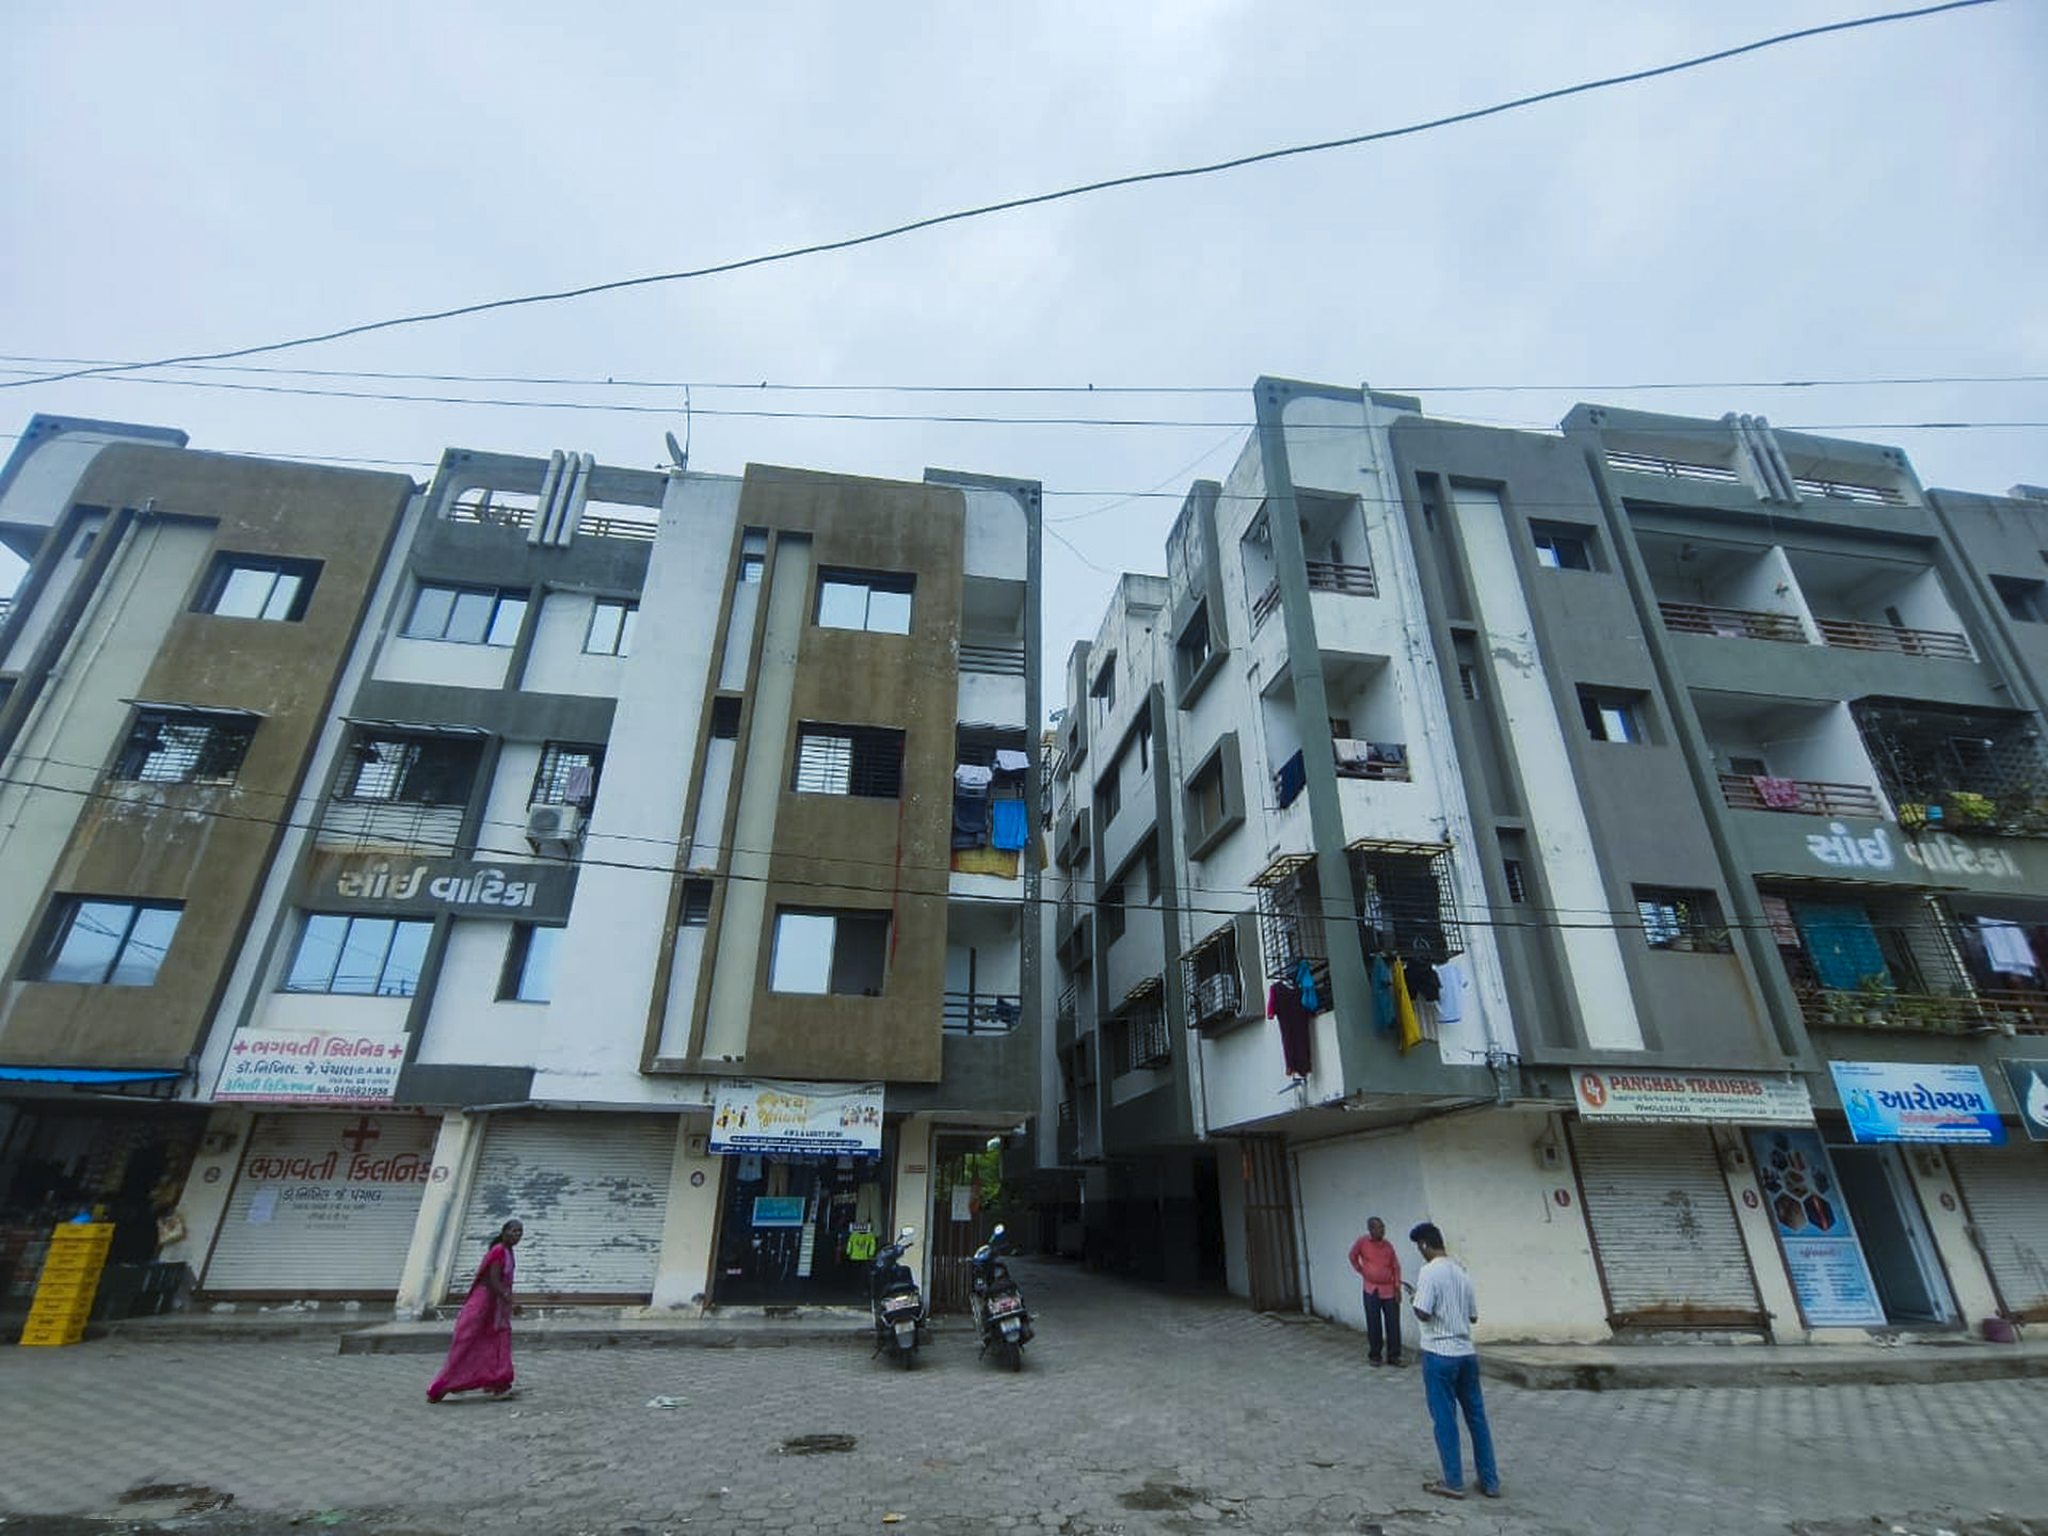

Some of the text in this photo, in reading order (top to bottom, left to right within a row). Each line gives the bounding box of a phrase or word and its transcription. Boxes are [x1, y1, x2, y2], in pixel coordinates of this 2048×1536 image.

[430, 868, 538, 907] વાટિકા
[252, 1036, 320, 1057] ભગવતી
[1686, 1078, 1764, 1096] TRADERS
[1878, 1082, 1988, 1112] આરોગ્યમ
[248, 1151, 338, 1180] ભગવતી
